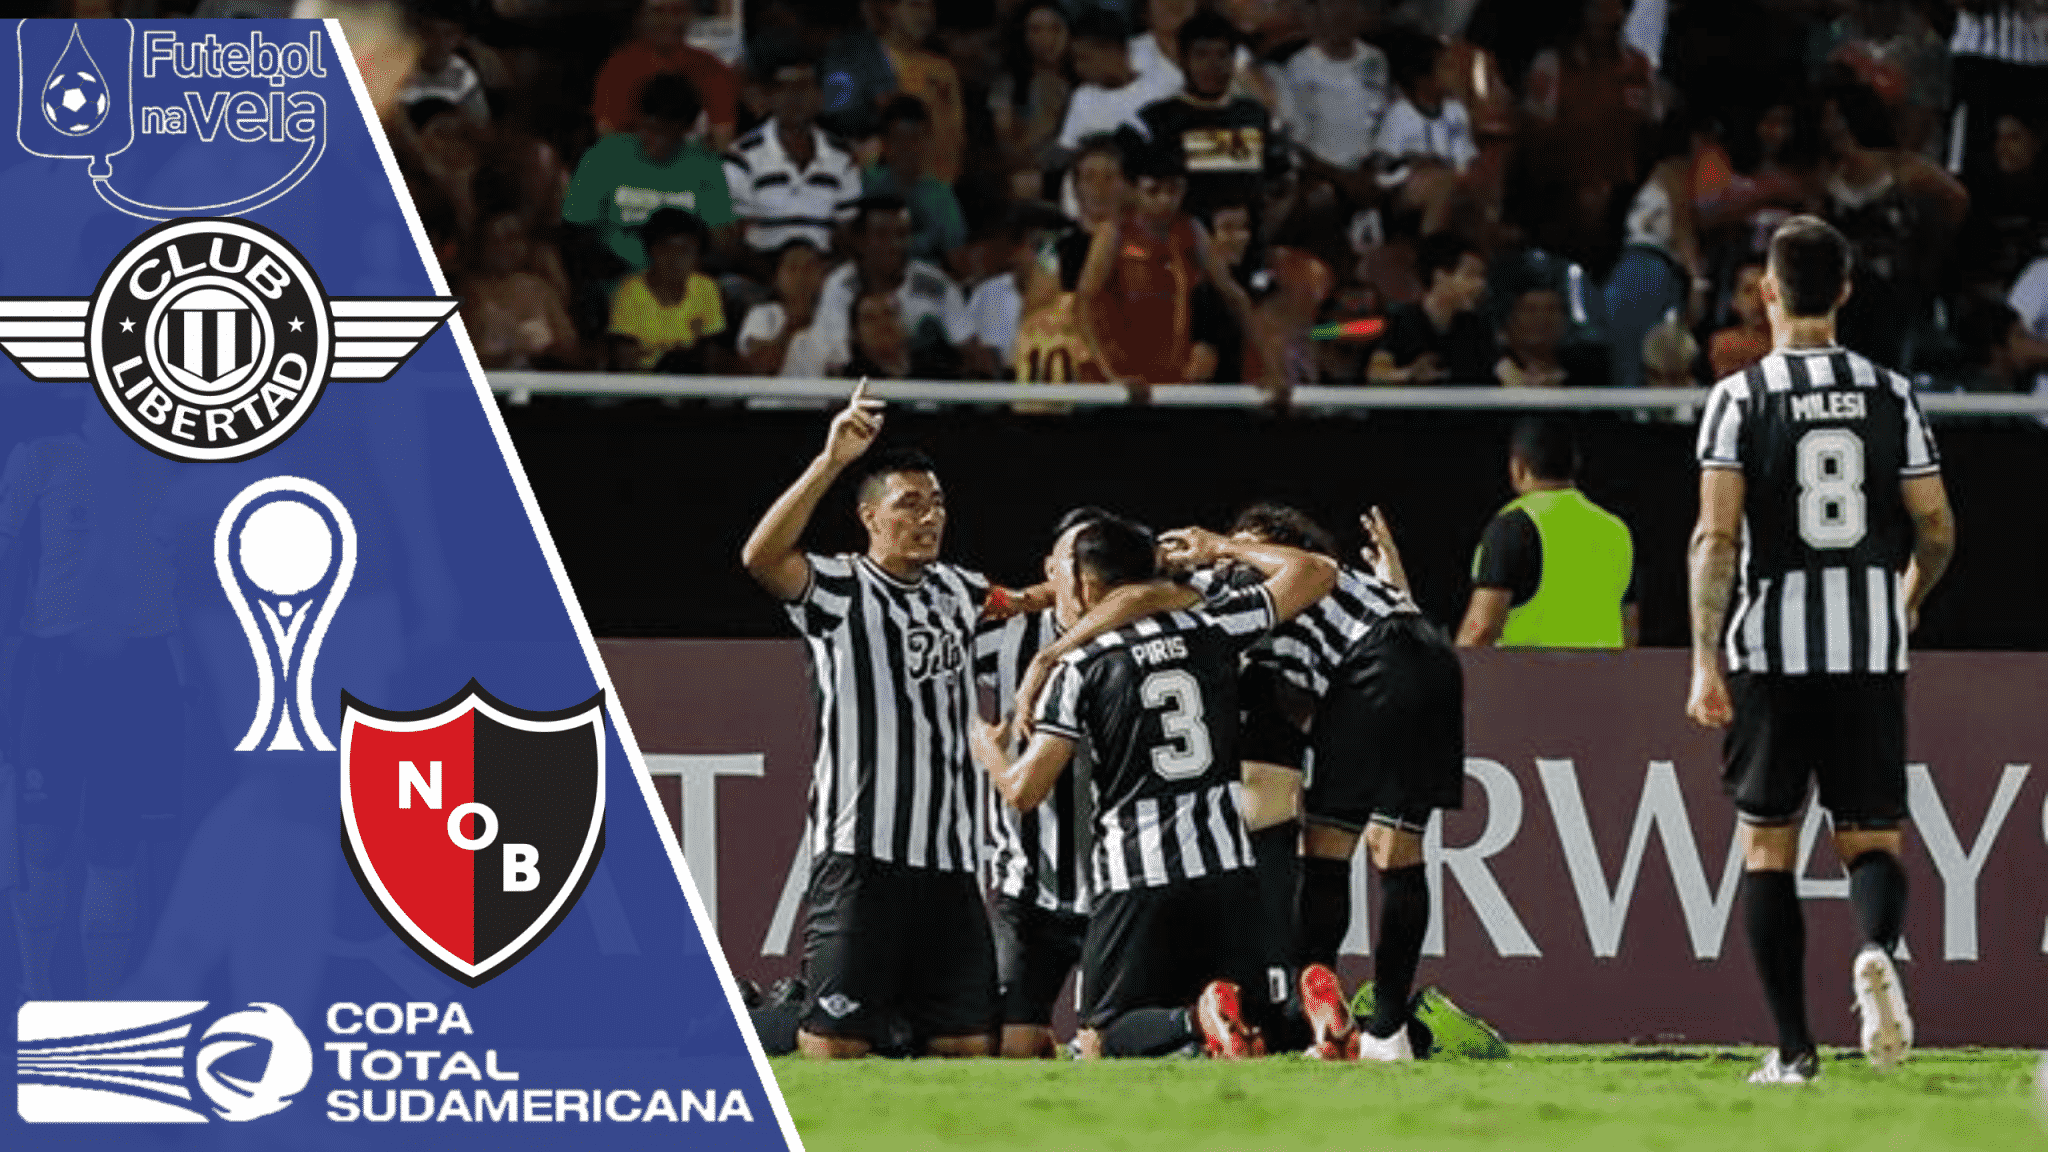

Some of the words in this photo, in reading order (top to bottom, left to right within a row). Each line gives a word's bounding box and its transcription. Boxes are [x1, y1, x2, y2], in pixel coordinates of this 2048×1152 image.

[1790, 391, 1867, 421] MILESI
[1796, 428, 1867, 549] 8
[1131, 635, 1189, 667] PIRIS
[1139, 669, 1214, 781] 3
